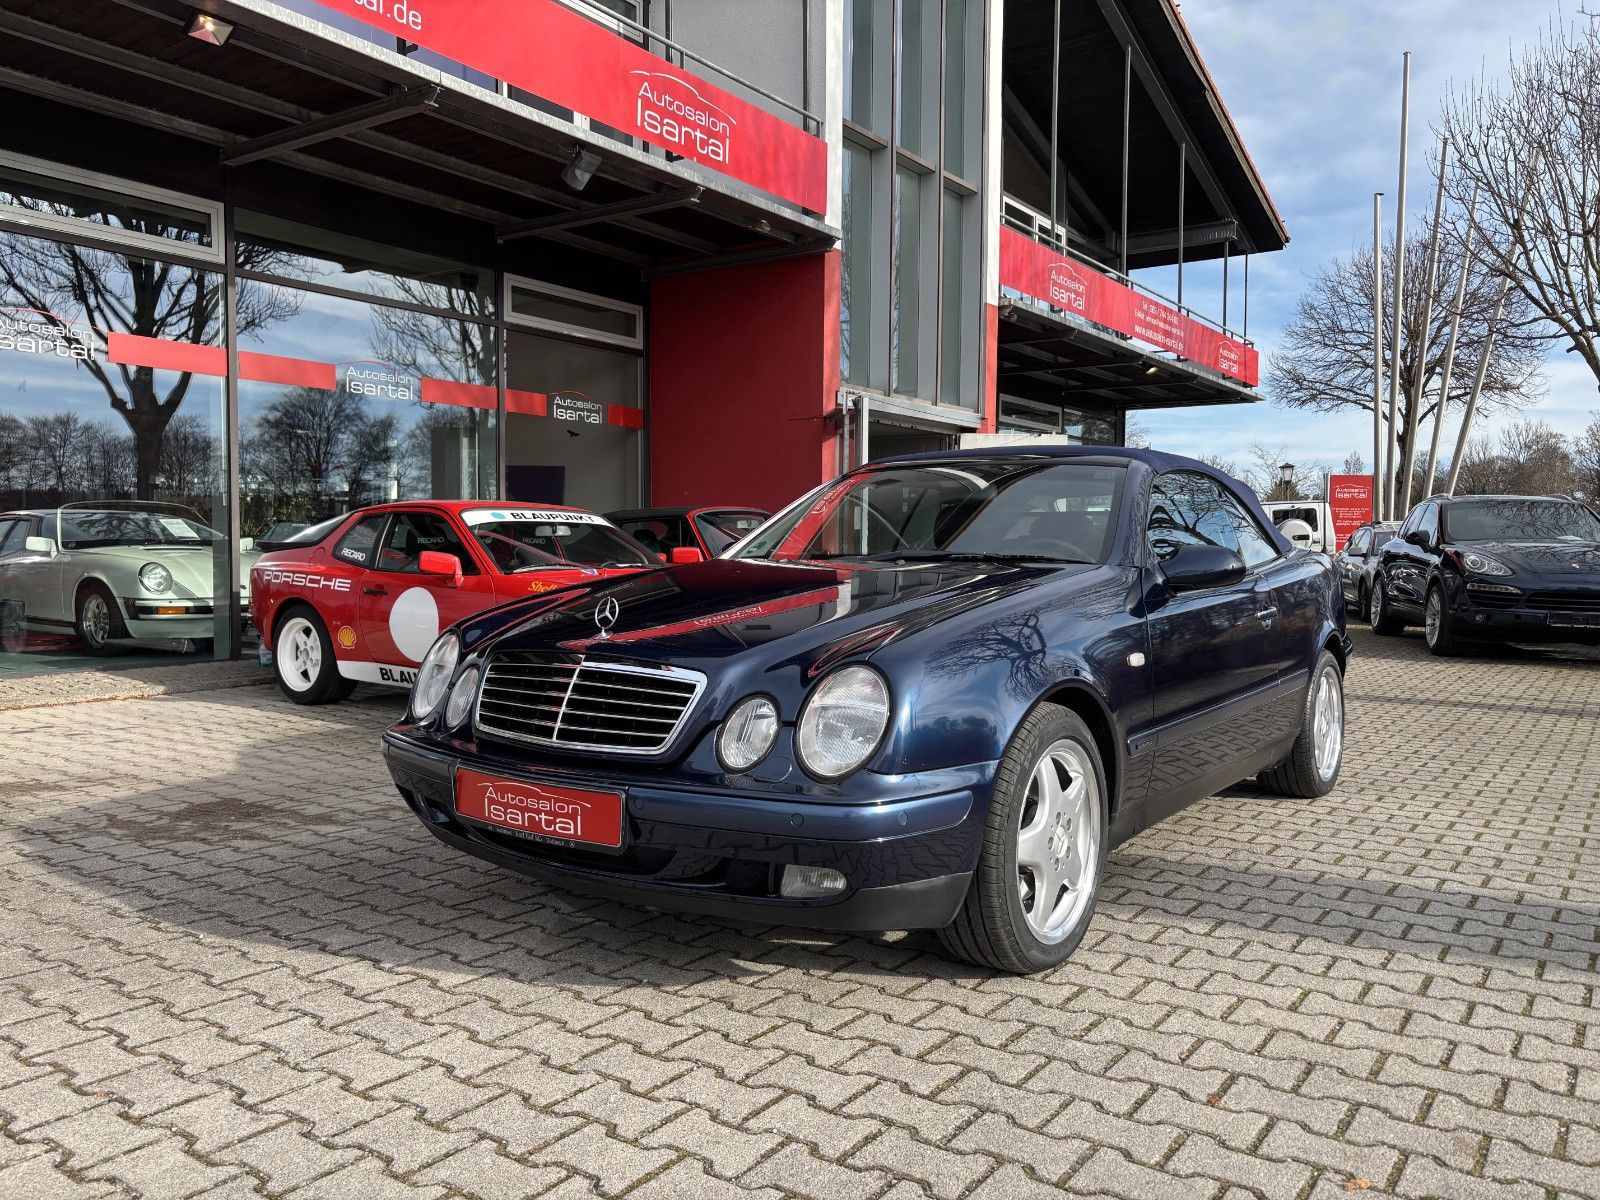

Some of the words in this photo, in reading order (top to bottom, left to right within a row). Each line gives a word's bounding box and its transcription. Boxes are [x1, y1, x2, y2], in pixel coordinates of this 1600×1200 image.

[354, 0, 422, 30] al.de
[638, 81, 730, 137] Autosalon
[637, 97, 730, 165] Isartal
[1050, 269, 1086, 294] Autosalon
[1050, 279, 1086, 311] Isartal
[346, 366, 414, 385] Autosalon
[1218, 354, 1239, 374] Isartal
[346, 375, 414, 401] Isartal
[553, 395, 603, 411] Autosalon
[553, 404, 603, 424] Isartal
[509, 511, 595, 523] BLAUPUNKT
[340, 547, 367, 562] RECARO
[263, 571, 352, 592] PORSCHE
[485, 786, 581, 815] Autosalon
[484, 797, 582, 836] Isartal
